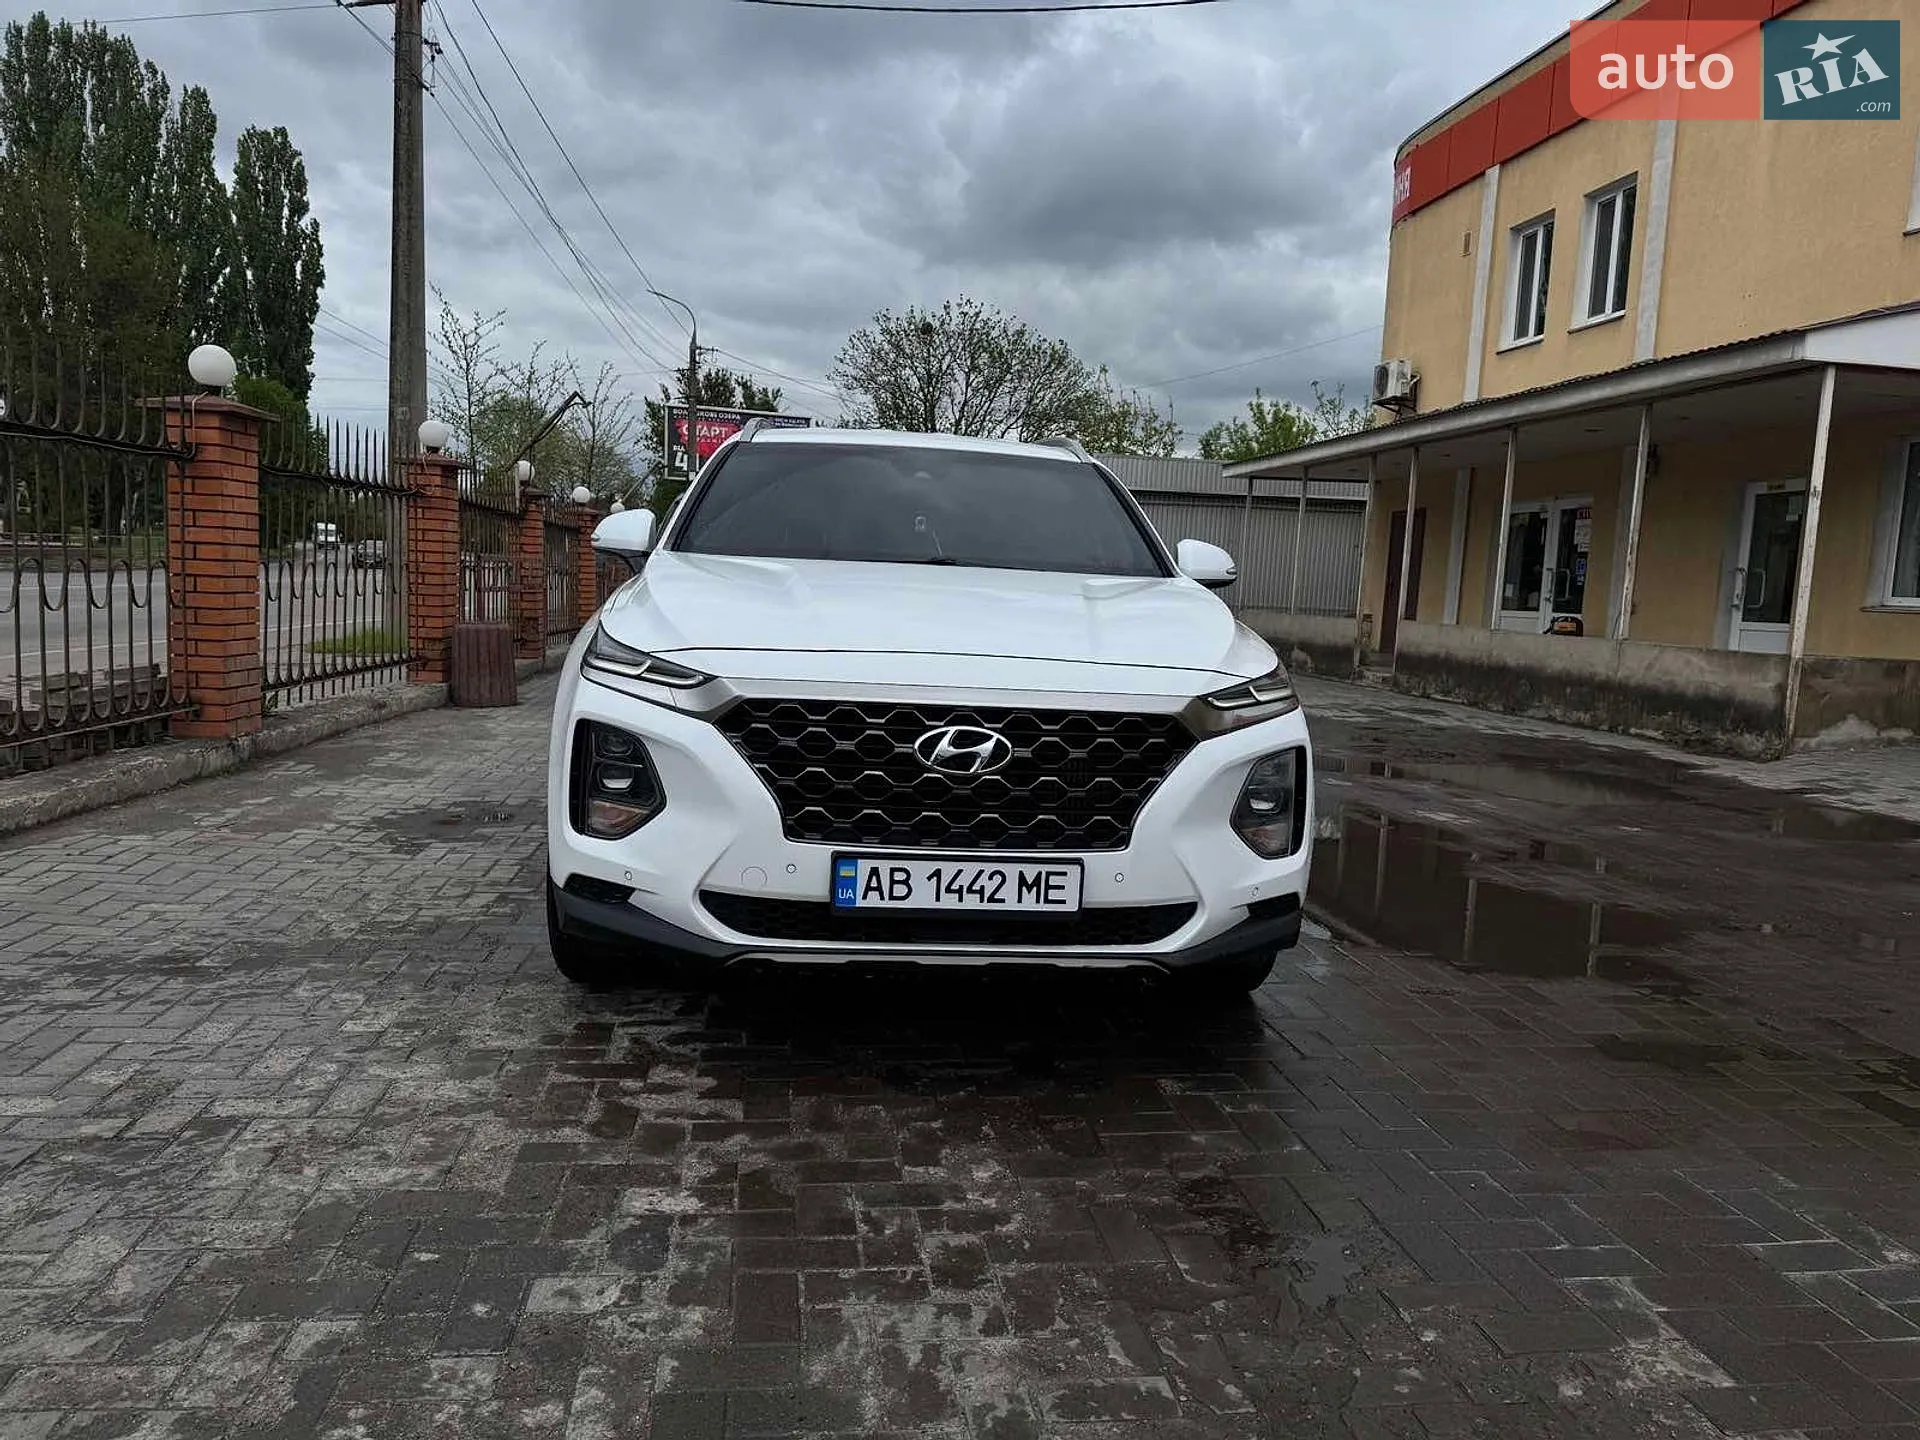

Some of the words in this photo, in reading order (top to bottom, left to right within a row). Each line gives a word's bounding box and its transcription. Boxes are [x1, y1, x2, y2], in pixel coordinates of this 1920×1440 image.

[838, 889, 855, 899] UA
[861, 866, 913, 901] AB
[926, 867, 1007, 904] 1442
[1016, 869, 1068, 905] ME
